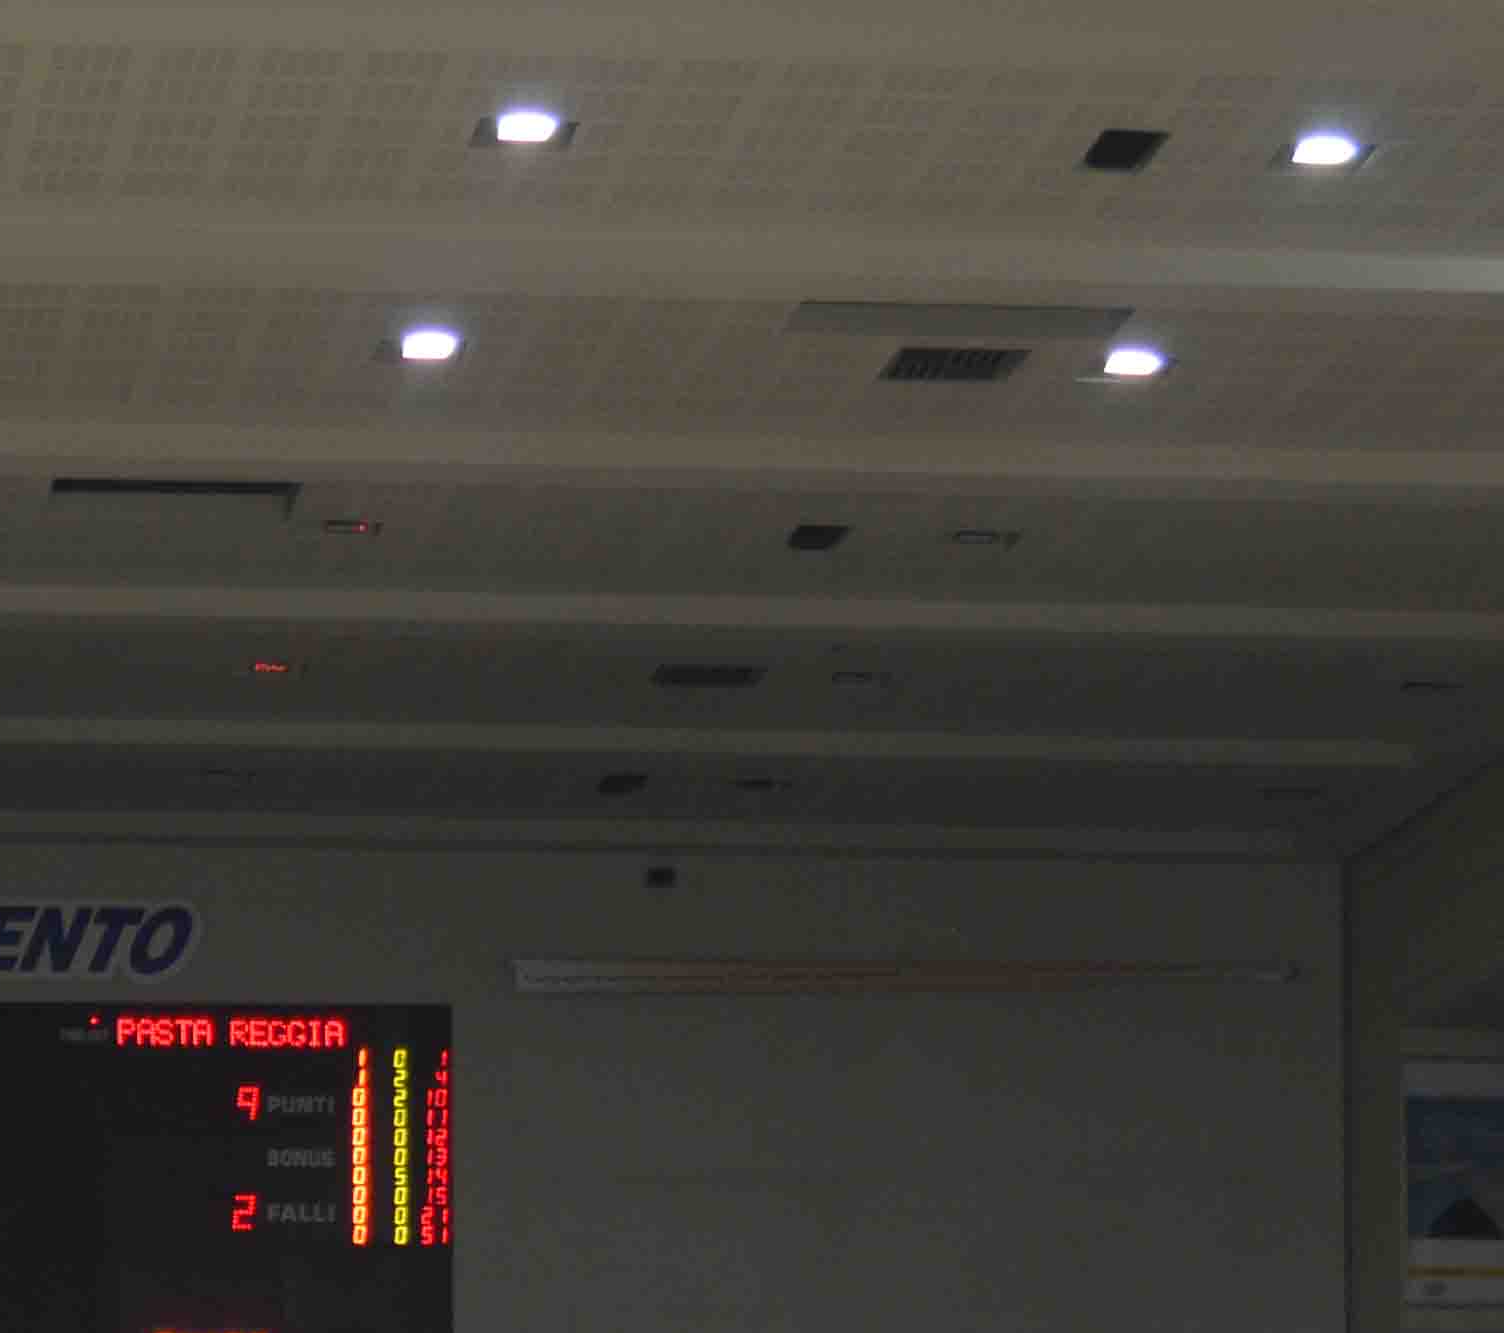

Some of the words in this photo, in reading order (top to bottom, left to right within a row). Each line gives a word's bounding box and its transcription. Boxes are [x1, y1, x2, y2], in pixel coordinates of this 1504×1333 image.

[116, 1017, 213, 1047] PASTA
[230, 1019, 344, 1048] REGGIA
[394, 1069, 408, 1087] 2
[236, 1085, 261, 1121] 9
[267, 1096, 336, 1114] PUNTI
[394, 1088, 408, 1106] 2
[267, 1149, 336, 1167] BONUS
[394, 1167, 408, 1184] 5
[232, 1195, 257, 1231] 2
[267, 1204, 336, 1222] FALLI
[394, 1226, 408, 1244] 0
